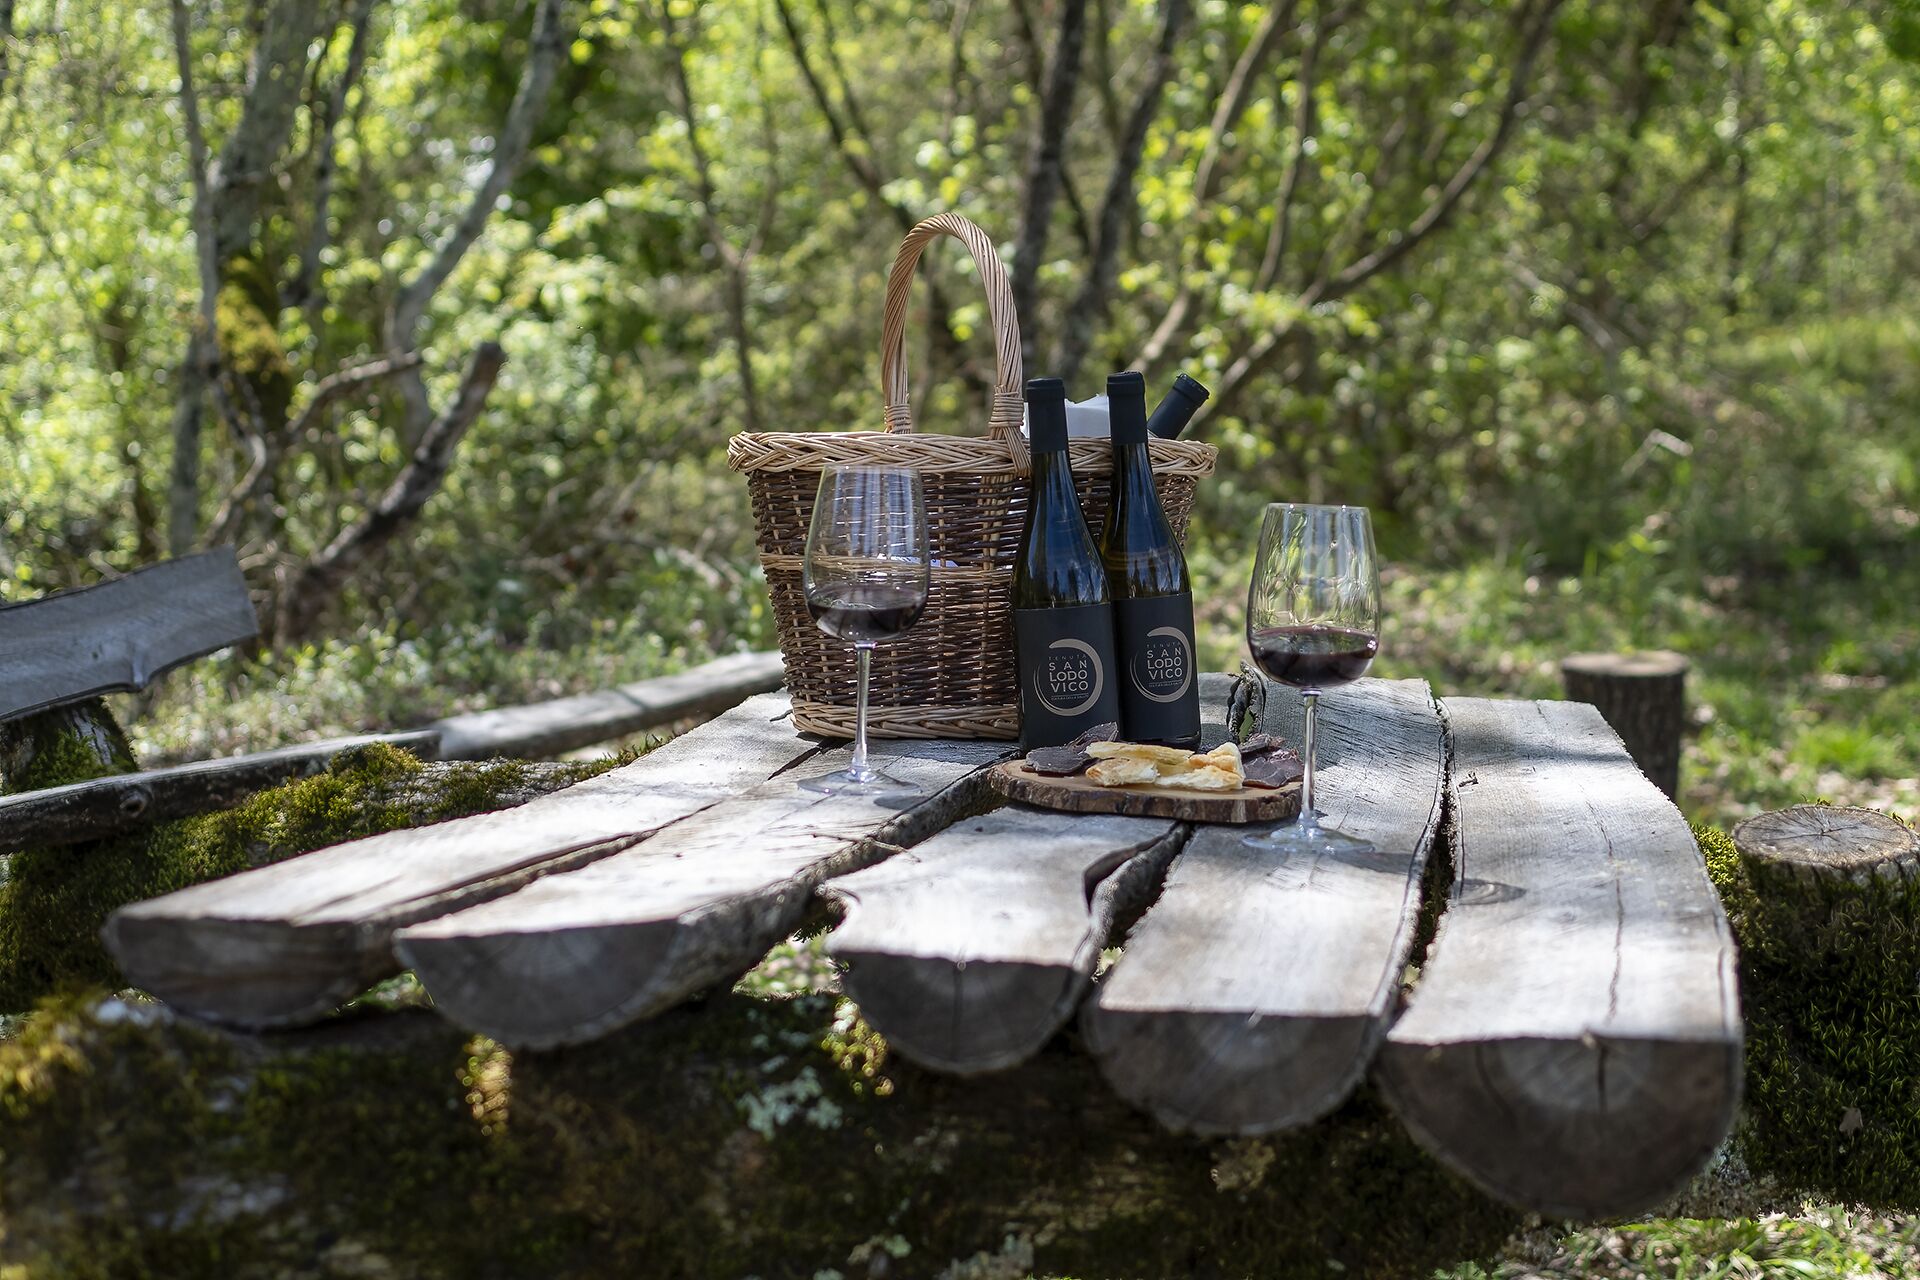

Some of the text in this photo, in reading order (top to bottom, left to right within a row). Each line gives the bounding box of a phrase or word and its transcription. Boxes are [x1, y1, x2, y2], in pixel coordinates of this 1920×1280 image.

[1147, 647, 1181, 659] SAN
[1048, 660, 1087, 671] SAN
[1147, 656, 1182, 669] LODO
[1049, 670, 1088, 682] LODO
[1148, 667, 1183, 680] VICO
[1050, 680, 1089, 693] VICO
